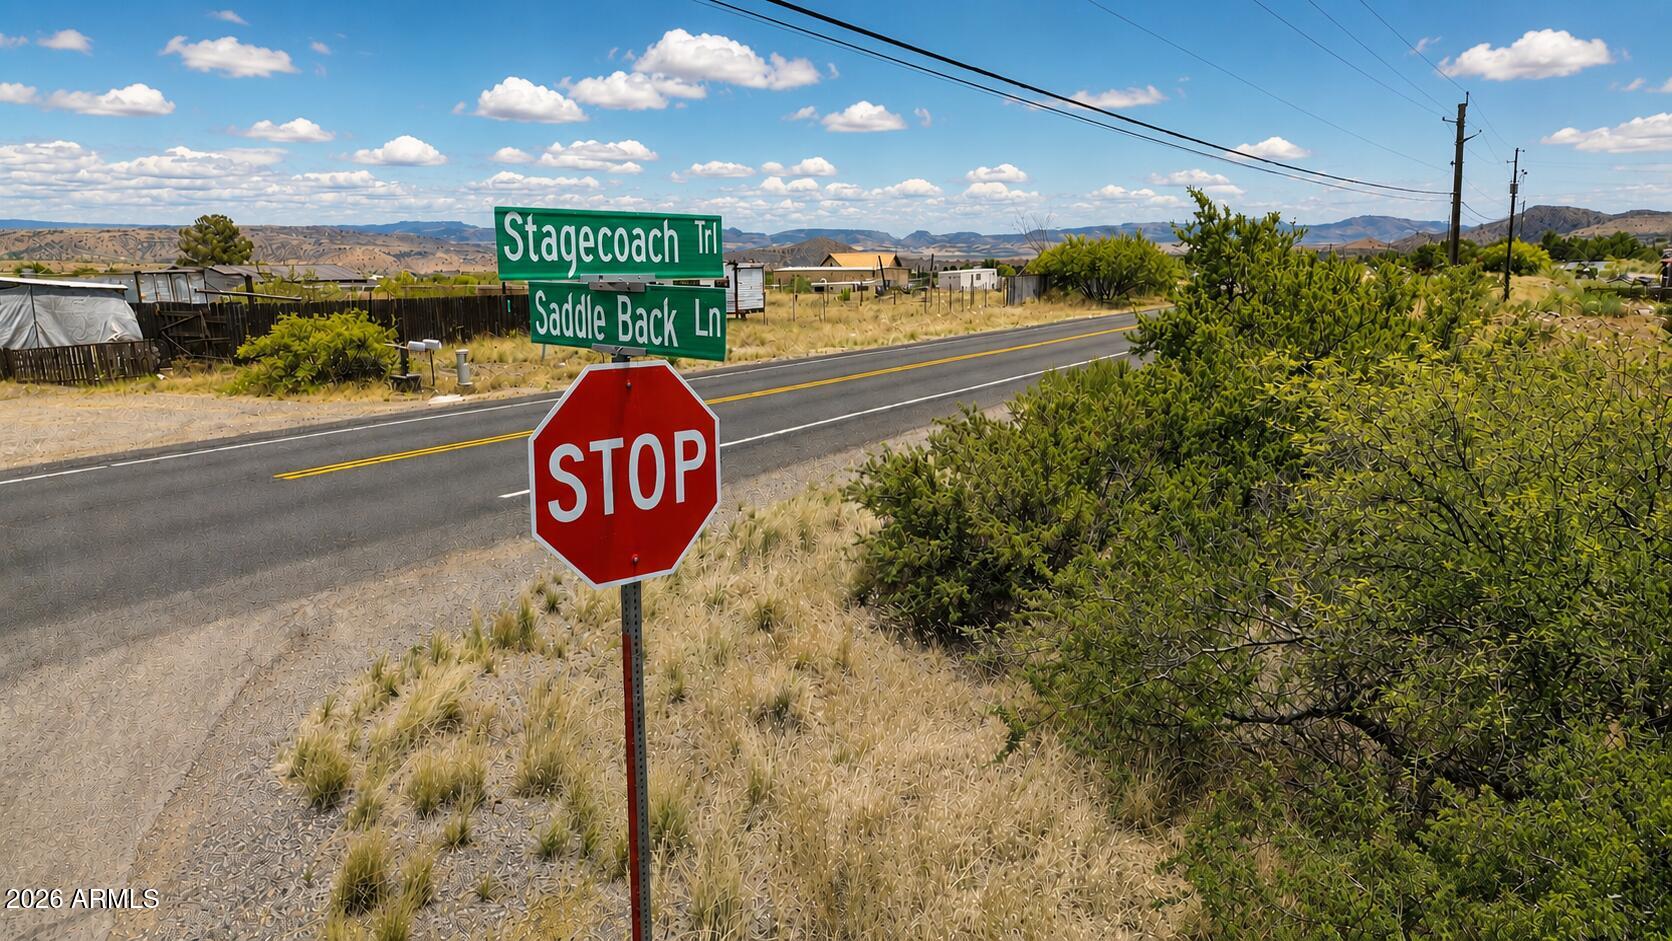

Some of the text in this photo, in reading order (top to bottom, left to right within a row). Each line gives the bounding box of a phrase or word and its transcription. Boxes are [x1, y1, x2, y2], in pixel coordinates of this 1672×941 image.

[503, 211, 718, 279] Stagecoach Trl
[535, 289, 721, 348] Saddle Back Ln
[548, 429, 707, 523] STOP
